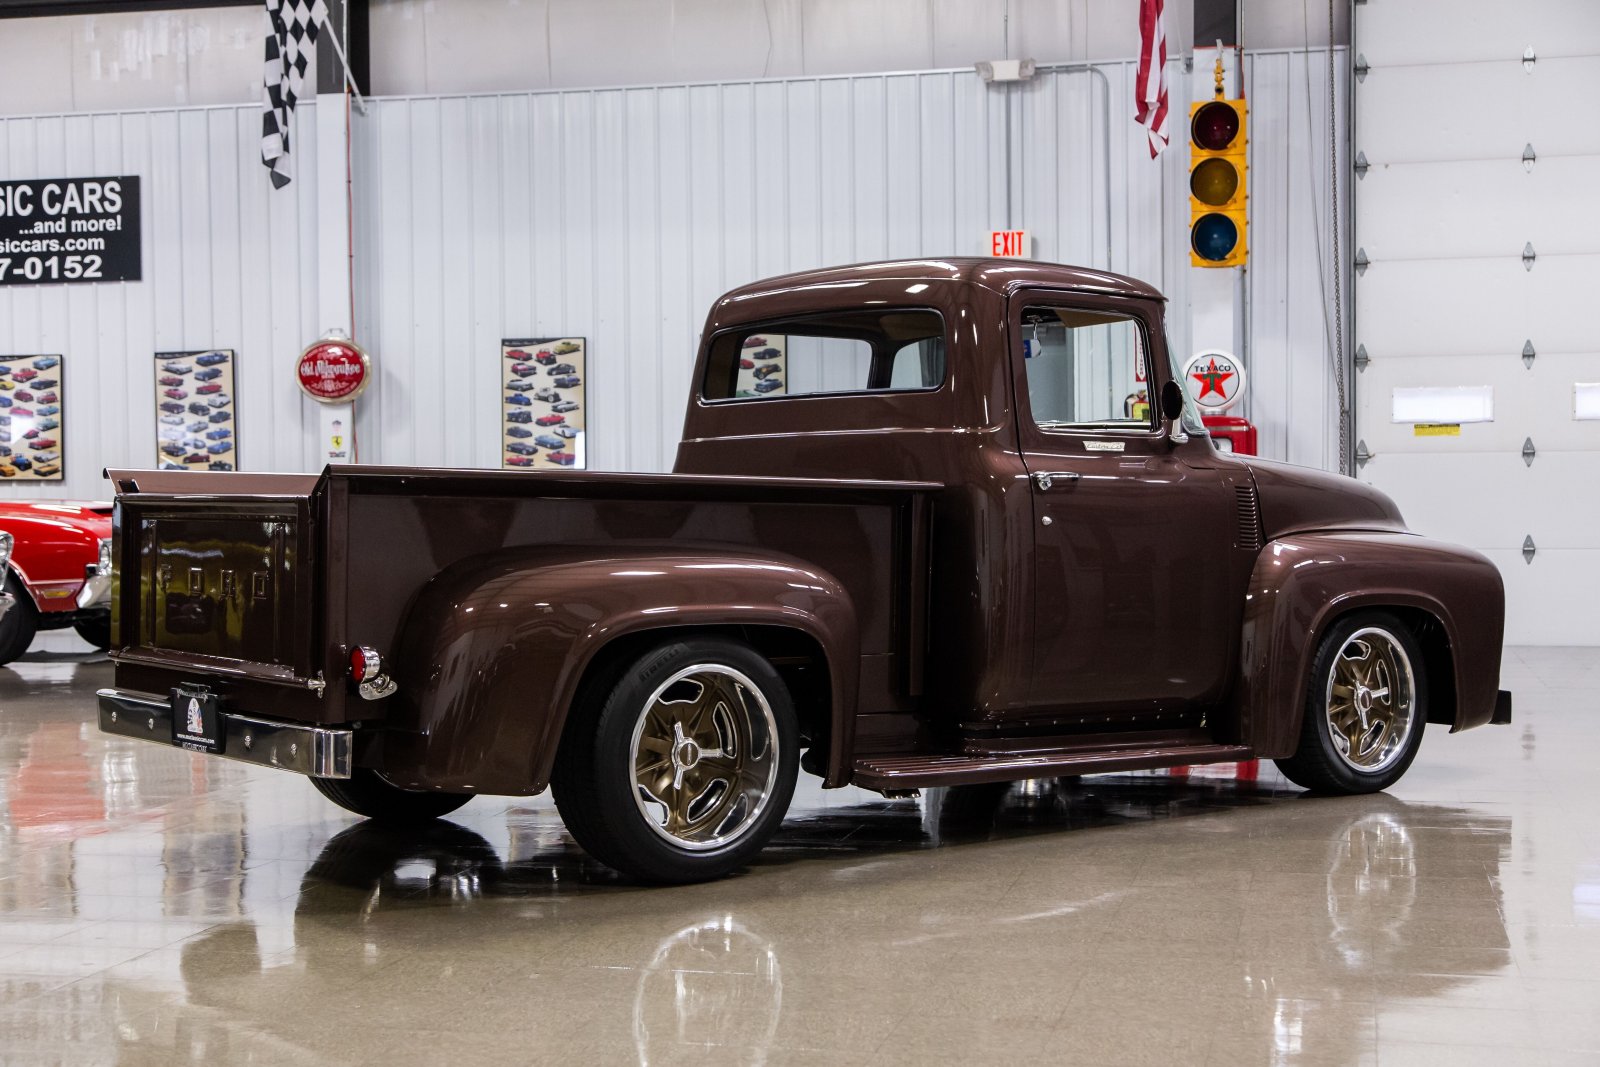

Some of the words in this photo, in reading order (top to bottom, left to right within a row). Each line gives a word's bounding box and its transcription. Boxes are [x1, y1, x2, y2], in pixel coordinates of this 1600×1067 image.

[41, 181, 122, 215] CARS
[19, 217, 66, 234] ...and
[71, 214, 122, 233] more!
[992, 231, 1024, 257] EXIT
[1194, 365, 1231, 373] TEXACO
